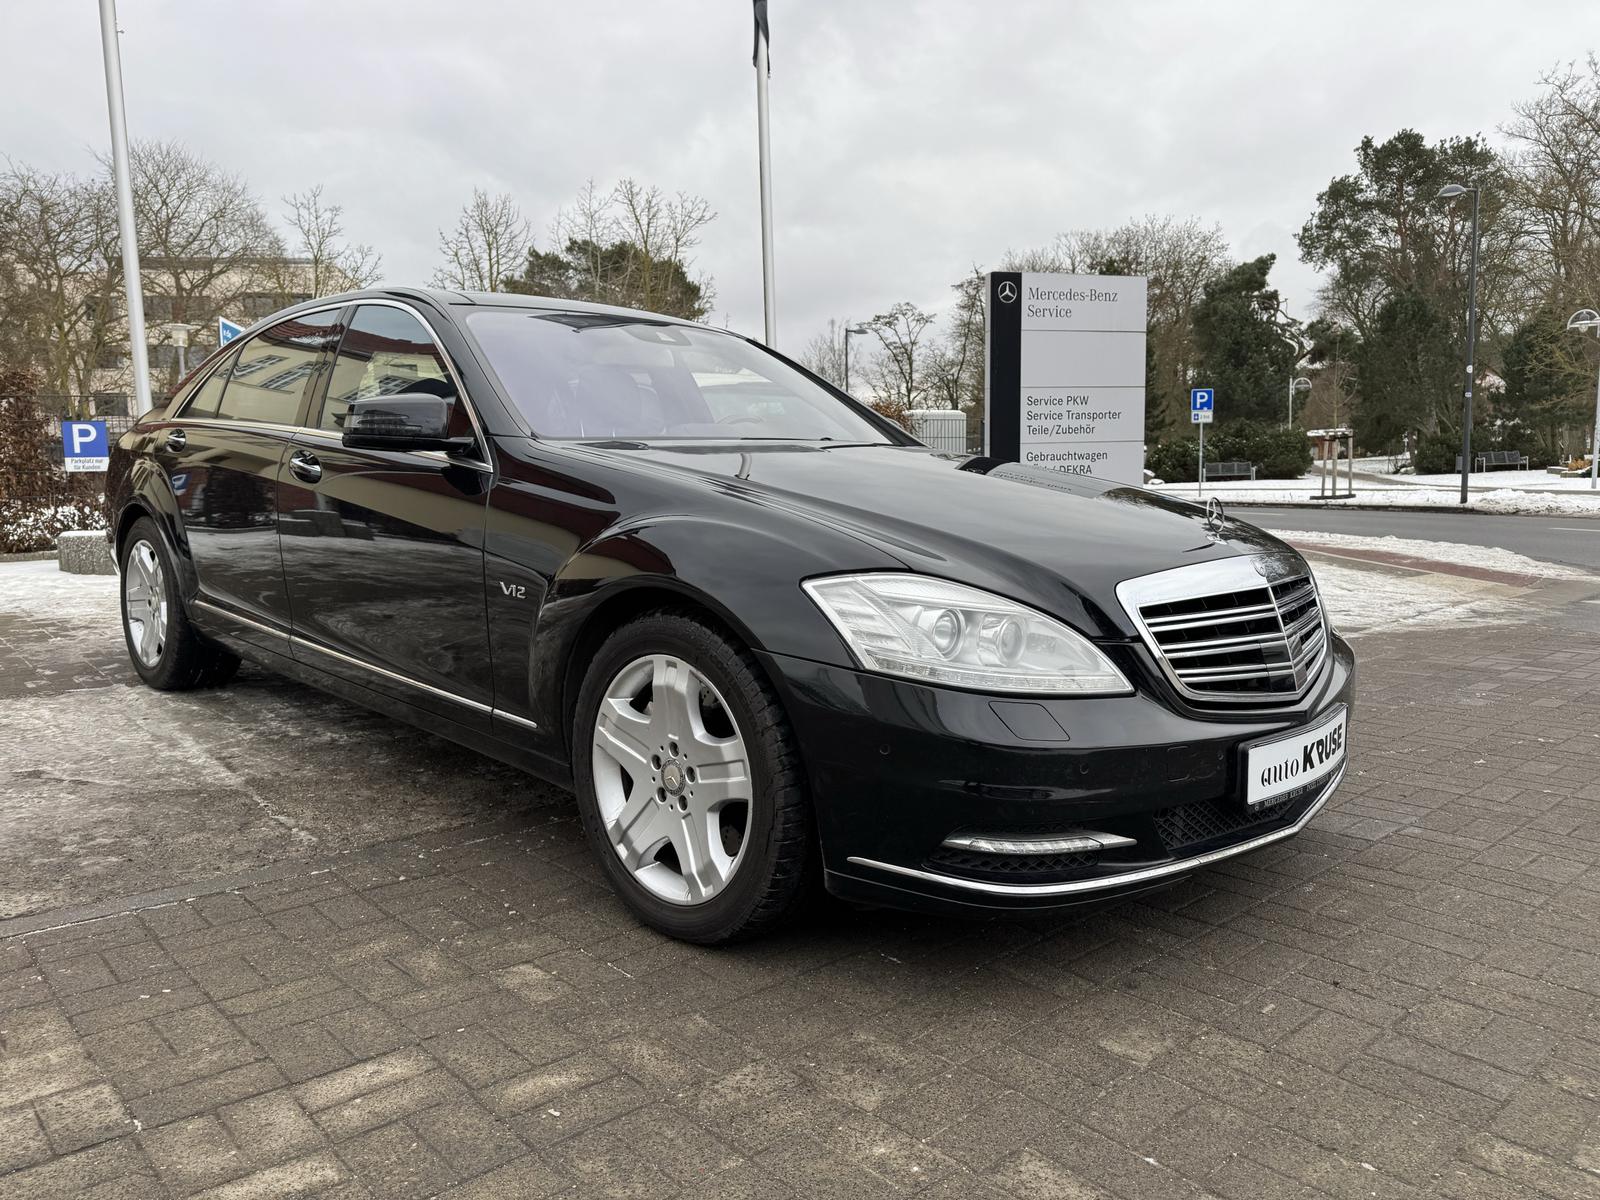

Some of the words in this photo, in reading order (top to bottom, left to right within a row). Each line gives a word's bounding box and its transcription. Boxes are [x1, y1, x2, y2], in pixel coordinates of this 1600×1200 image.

[1028, 287, 1118, 302] Mercedes-Benz
[1027, 304, 1072, 318] Service
[1026, 395, 1064, 406] Service
[1066, 395, 1089, 406] PKW
[1196, 392, 1209, 409] P
[1026, 410, 1063, 421] Service
[1066, 409, 1122, 422] Transporter
[1026, 424, 1096, 437] Teile/Zubehör
[72, 423, 97, 454] P
[1026, 451, 1108, 462] Gebrauchtwagen
[1059, 464, 1093, 475] DEKRA
[500, 581, 526, 599] V12
[1261, 758, 1299, 788] auto
[1302, 722, 1343, 773] KRUSE
